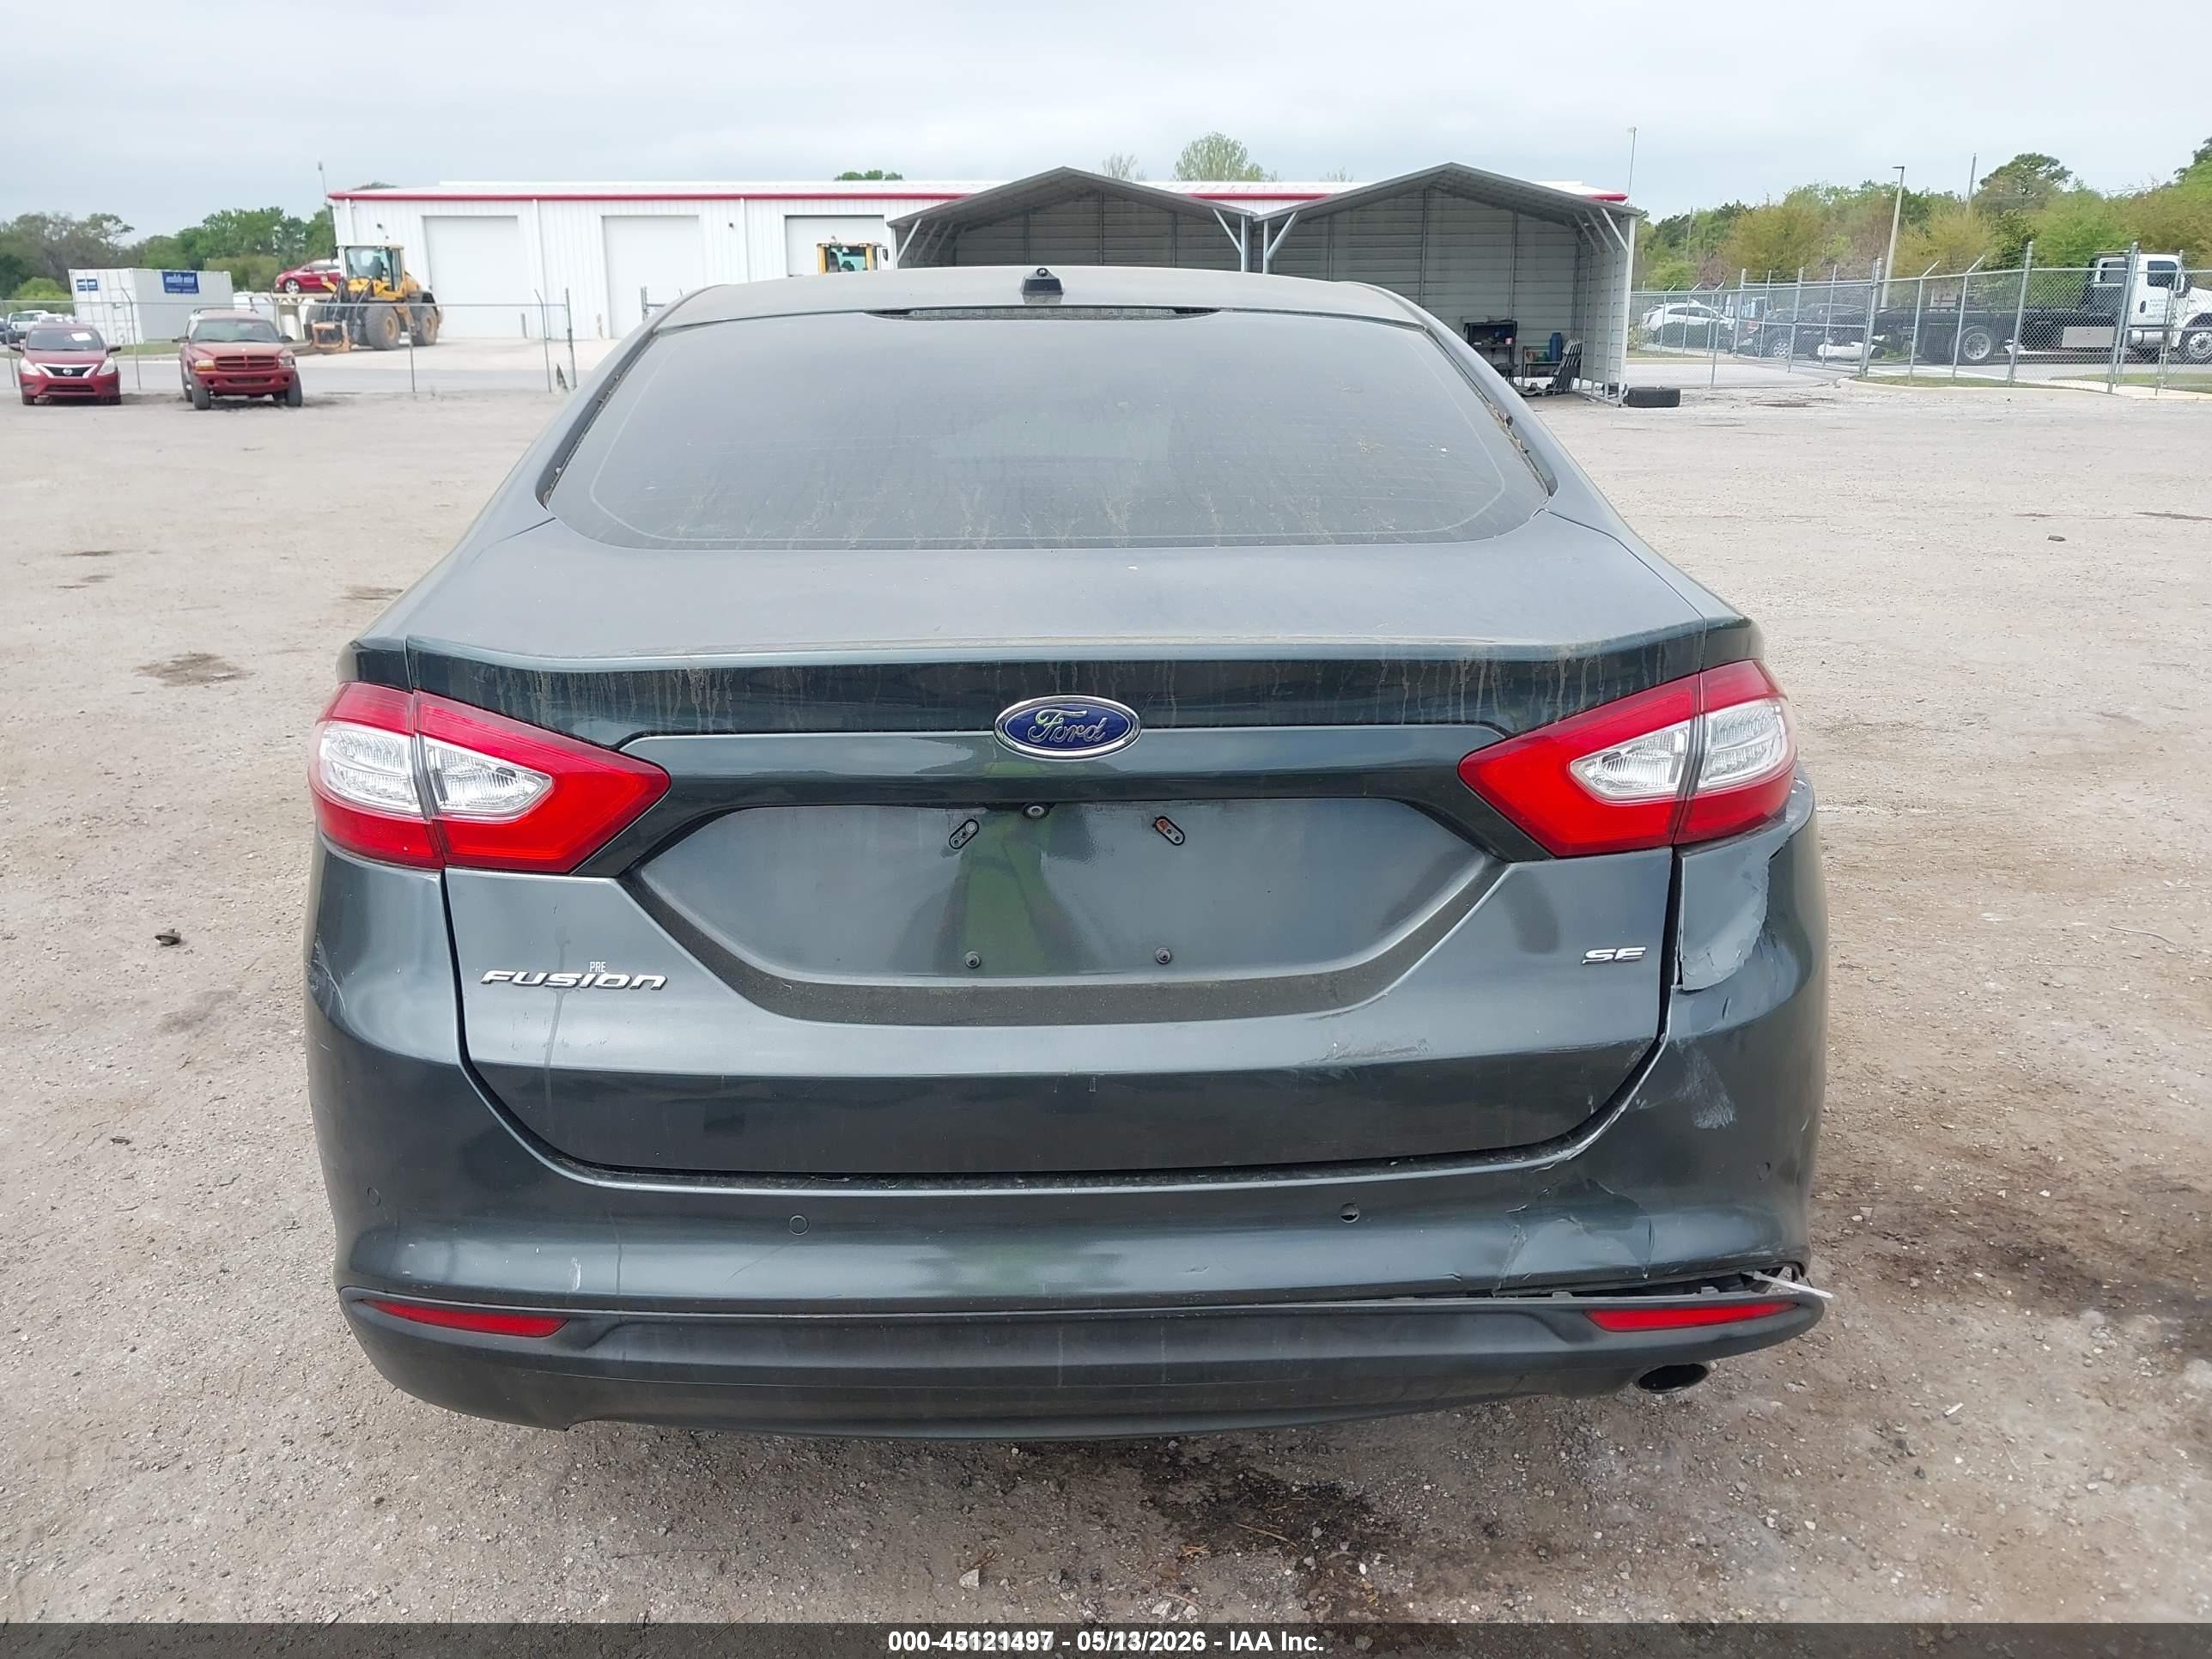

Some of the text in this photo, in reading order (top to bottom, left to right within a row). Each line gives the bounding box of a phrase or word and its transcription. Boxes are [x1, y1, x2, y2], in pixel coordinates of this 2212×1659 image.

[1028, 708, 1108, 743] Ford
[1581, 946, 1646, 964] SE
[481, 969, 667, 990] FUSION
